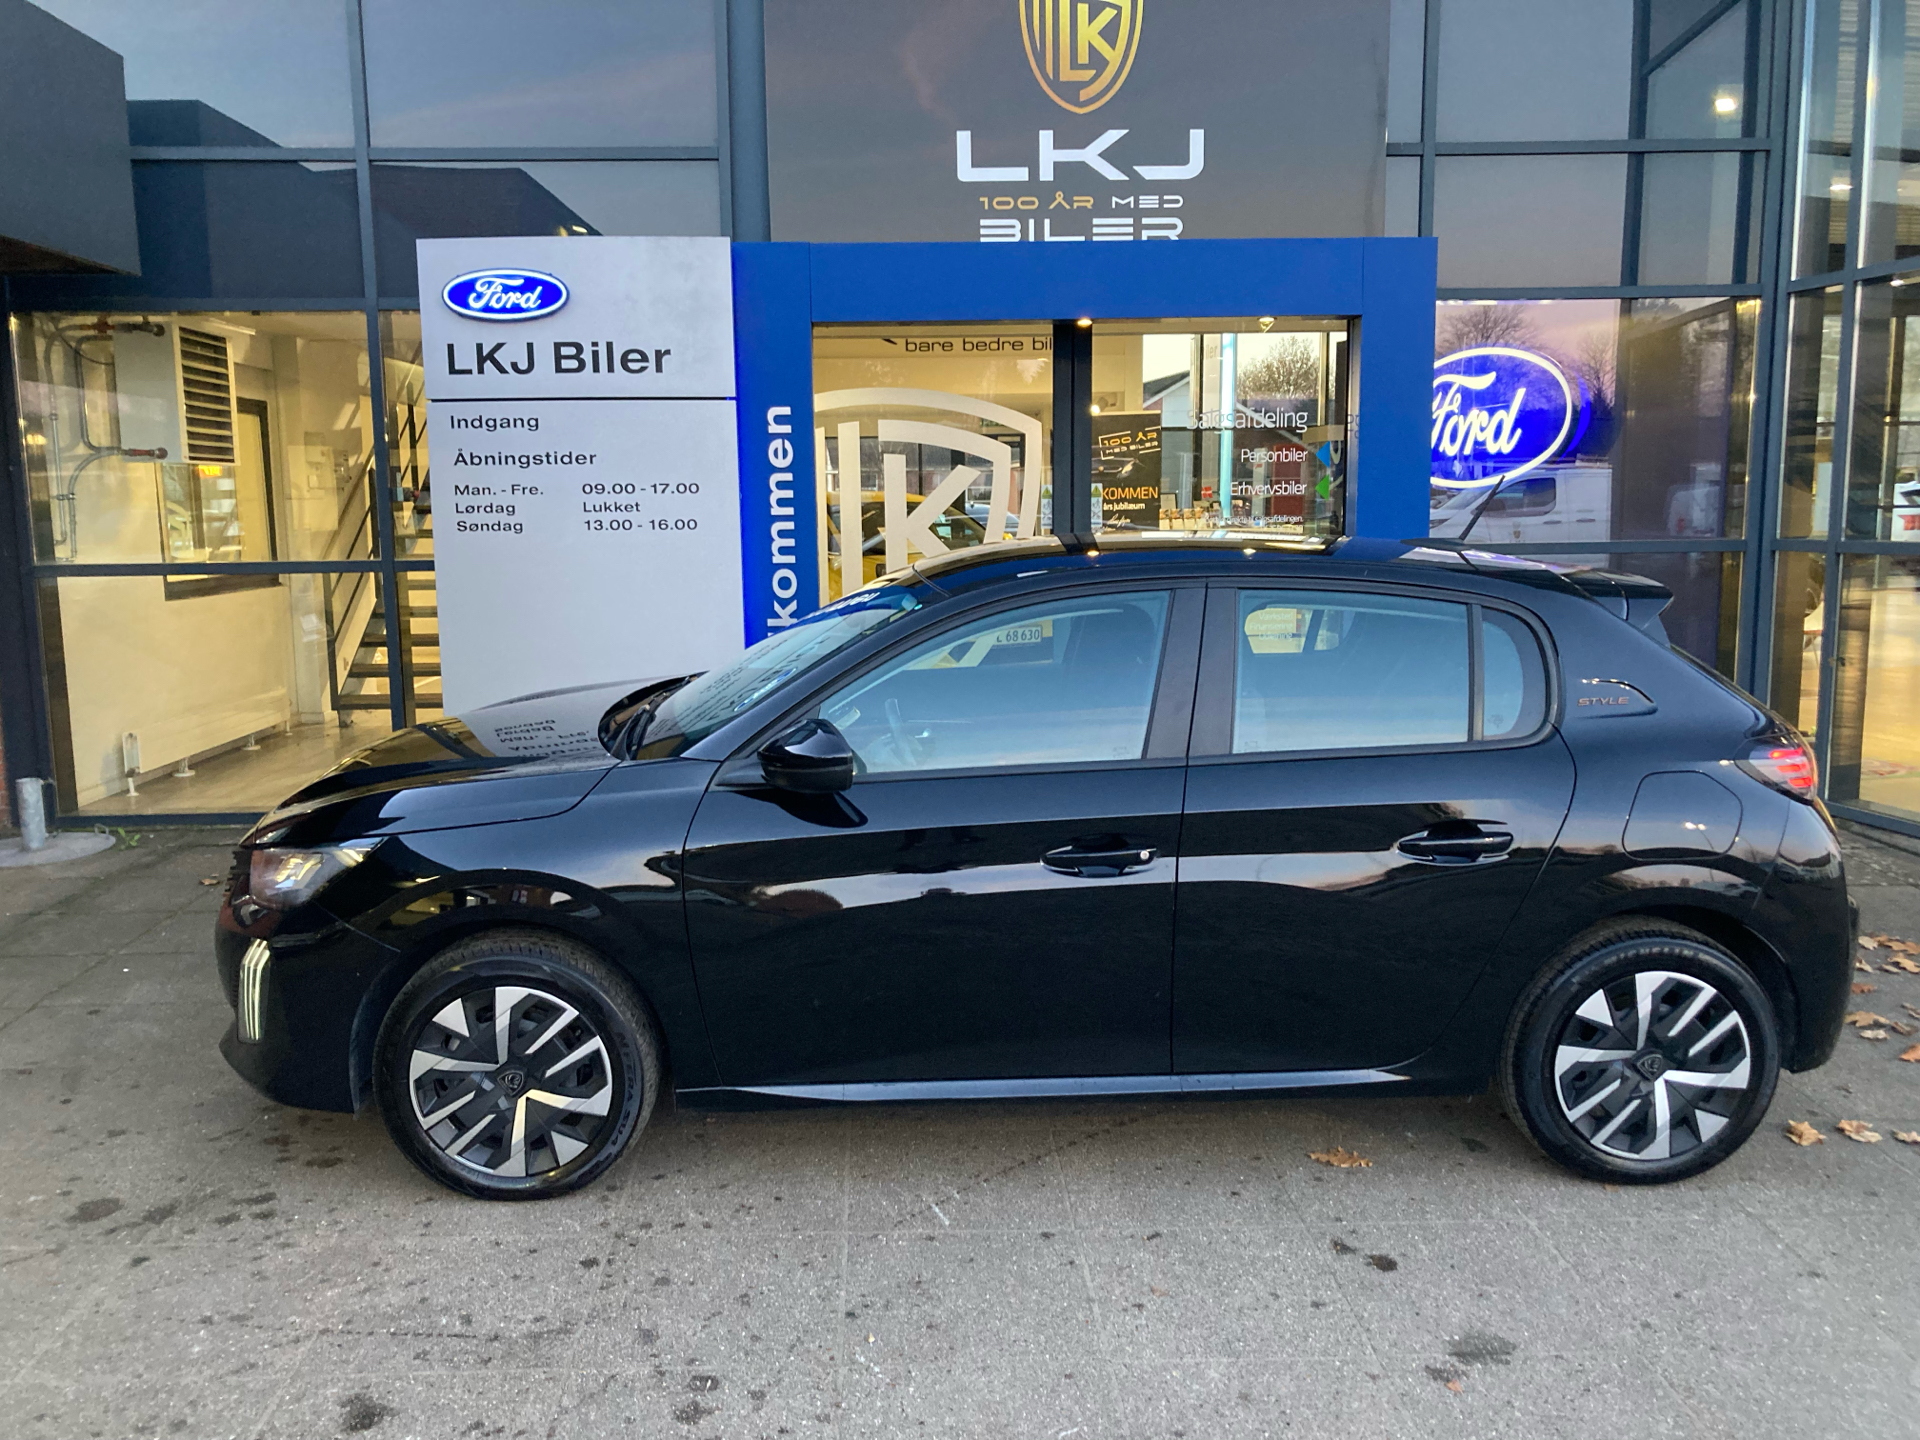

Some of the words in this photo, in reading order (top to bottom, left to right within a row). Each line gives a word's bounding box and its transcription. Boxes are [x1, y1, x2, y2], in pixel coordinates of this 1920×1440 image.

[957, 129, 1204, 182] LKJ
[979, 196, 1039, 210] 100
[1049, 191, 1094, 209] ÅR
[1112, 195, 1184, 209] MED
[980, 217, 1183, 242] BILER
[468, 276, 542, 311] Ford
[905, 338, 953, 352] bare
[963, 337, 1023, 351] bedre
[446, 342, 535, 376] LKJ
[554, 341, 671, 374] Biler
[1186, 407, 1309, 433] Salgsafdeling
[1432, 371, 1526, 456] Ford
[450, 414, 540, 432] Indgang
[1103, 436, 1131, 447] 100
[453, 448, 596, 469] Åbningstider
[1241, 449, 1308, 463] Personbiler
[454, 484, 498, 497] Man.
[511, 484, 544, 497] Fre.
[582, 483, 636, 495] 09.00
[650, 482, 700, 494] 17.00
[1102, 486, 1158, 500] KOMMEN
[1230, 481, 1307, 496] Erhvervsbiler
[455, 501, 516, 517] Lørdag
[583, 501, 641, 513] Lukket
[456, 519, 523, 534] Søndag
[584, 519, 633, 531] 13.00
[649, 518, 698, 531] 16.00
[766, 405, 798, 637] kommen
[1577, 697, 1629, 706] STYLE
